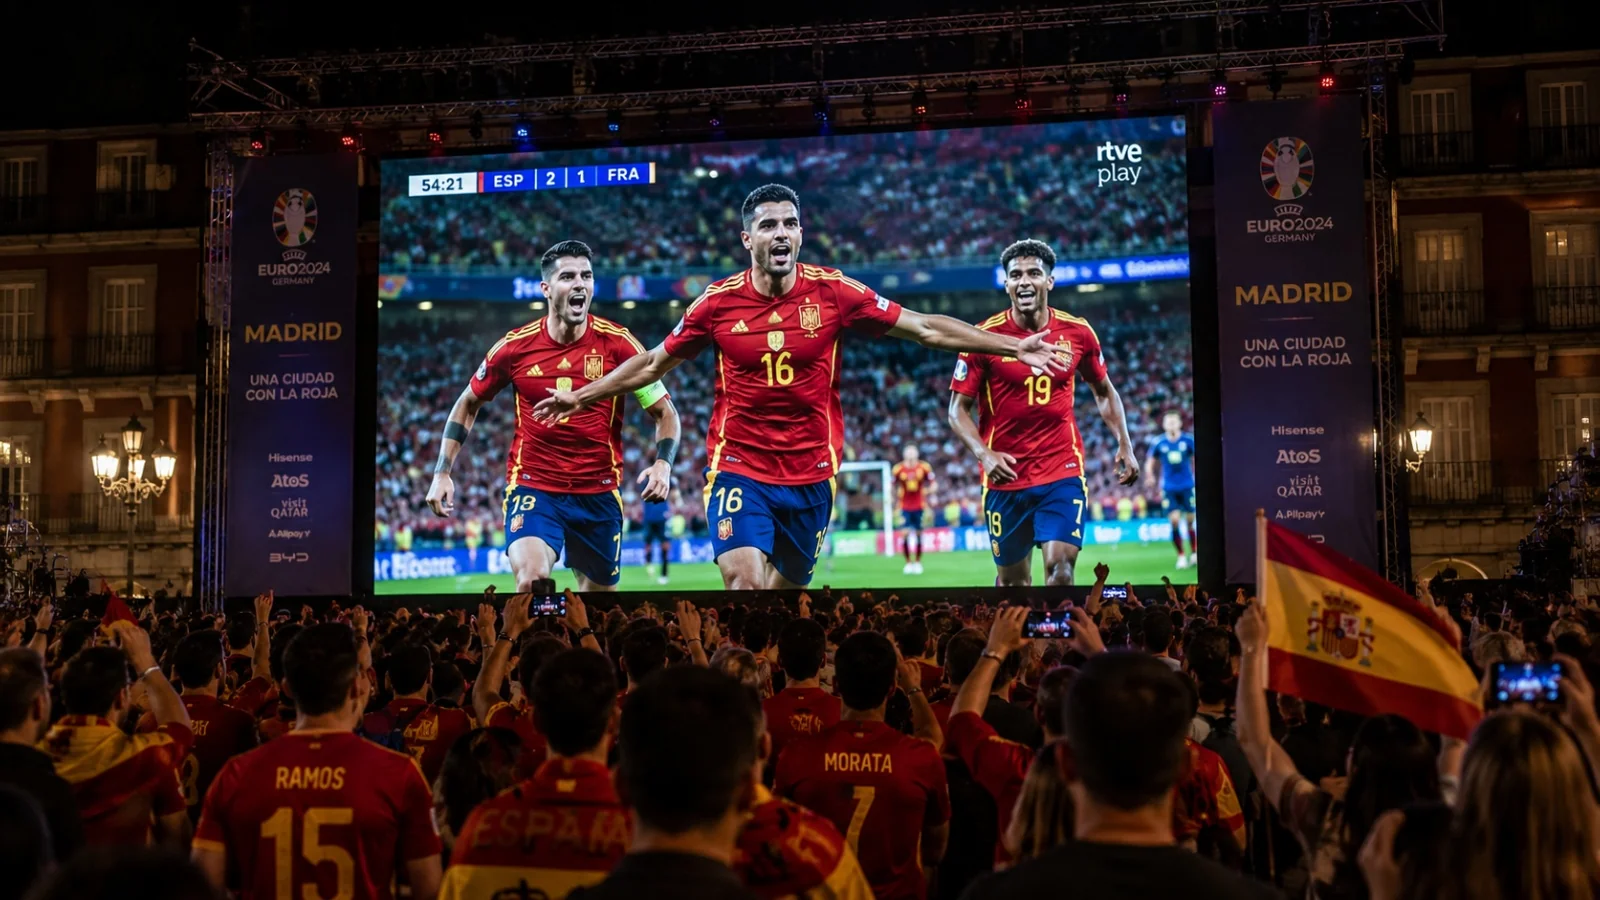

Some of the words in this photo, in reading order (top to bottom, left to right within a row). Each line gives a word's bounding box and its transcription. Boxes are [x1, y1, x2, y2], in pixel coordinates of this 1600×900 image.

[1097, 141, 1142, 162] rtve
[421, 177, 464, 192] 54:21
[493, 174, 524, 188] ESP
[545, 171, 556, 186] 2
[577, 170, 585, 184] 1
[607, 167, 640, 182] FRA
[1097, 163, 1142, 187] play
[1246, 216, 1334, 234] EURO2024
[1264, 233, 1316, 243] GERMANY
[258, 261, 331, 276] EURO2024
[272, 276, 315, 286] GERMANY
[1235, 281, 1353, 306] MADRID
[244, 321, 343, 343] MADRID
[1244, 338, 1280, 352] UNA
[1283, 336, 1346, 350] CIUDAD
[761, 351, 794, 386] 16
[1240, 355, 1276, 368] CON
[1281, 354, 1303, 367] LA
[1307, 352, 1352, 367] ROJA
[250, 374, 279, 386] UNA
[282, 372, 335, 385] CIUDAD
[245, 388, 276, 401] CON
[280, 388, 298, 400] LA
[301, 386, 339, 400] ROJA
[1024, 375, 1051, 406] 19
[1271, 425, 1324, 435] Hisense
[268, 452, 313, 462] Hisense
[715, 487, 743, 516] 16
[1276, 486, 1322, 498] QATAR
[270, 507, 308, 519] QATAR
[1073, 499, 1083, 524] 7
[269, 552, 309, 563] BYD
[824, 751, 893, 774] MORATA
[275, 766, 347, 790] RAMOS
[845, 785, 875, 854] 7
[260, 806, 355, 900] 15
